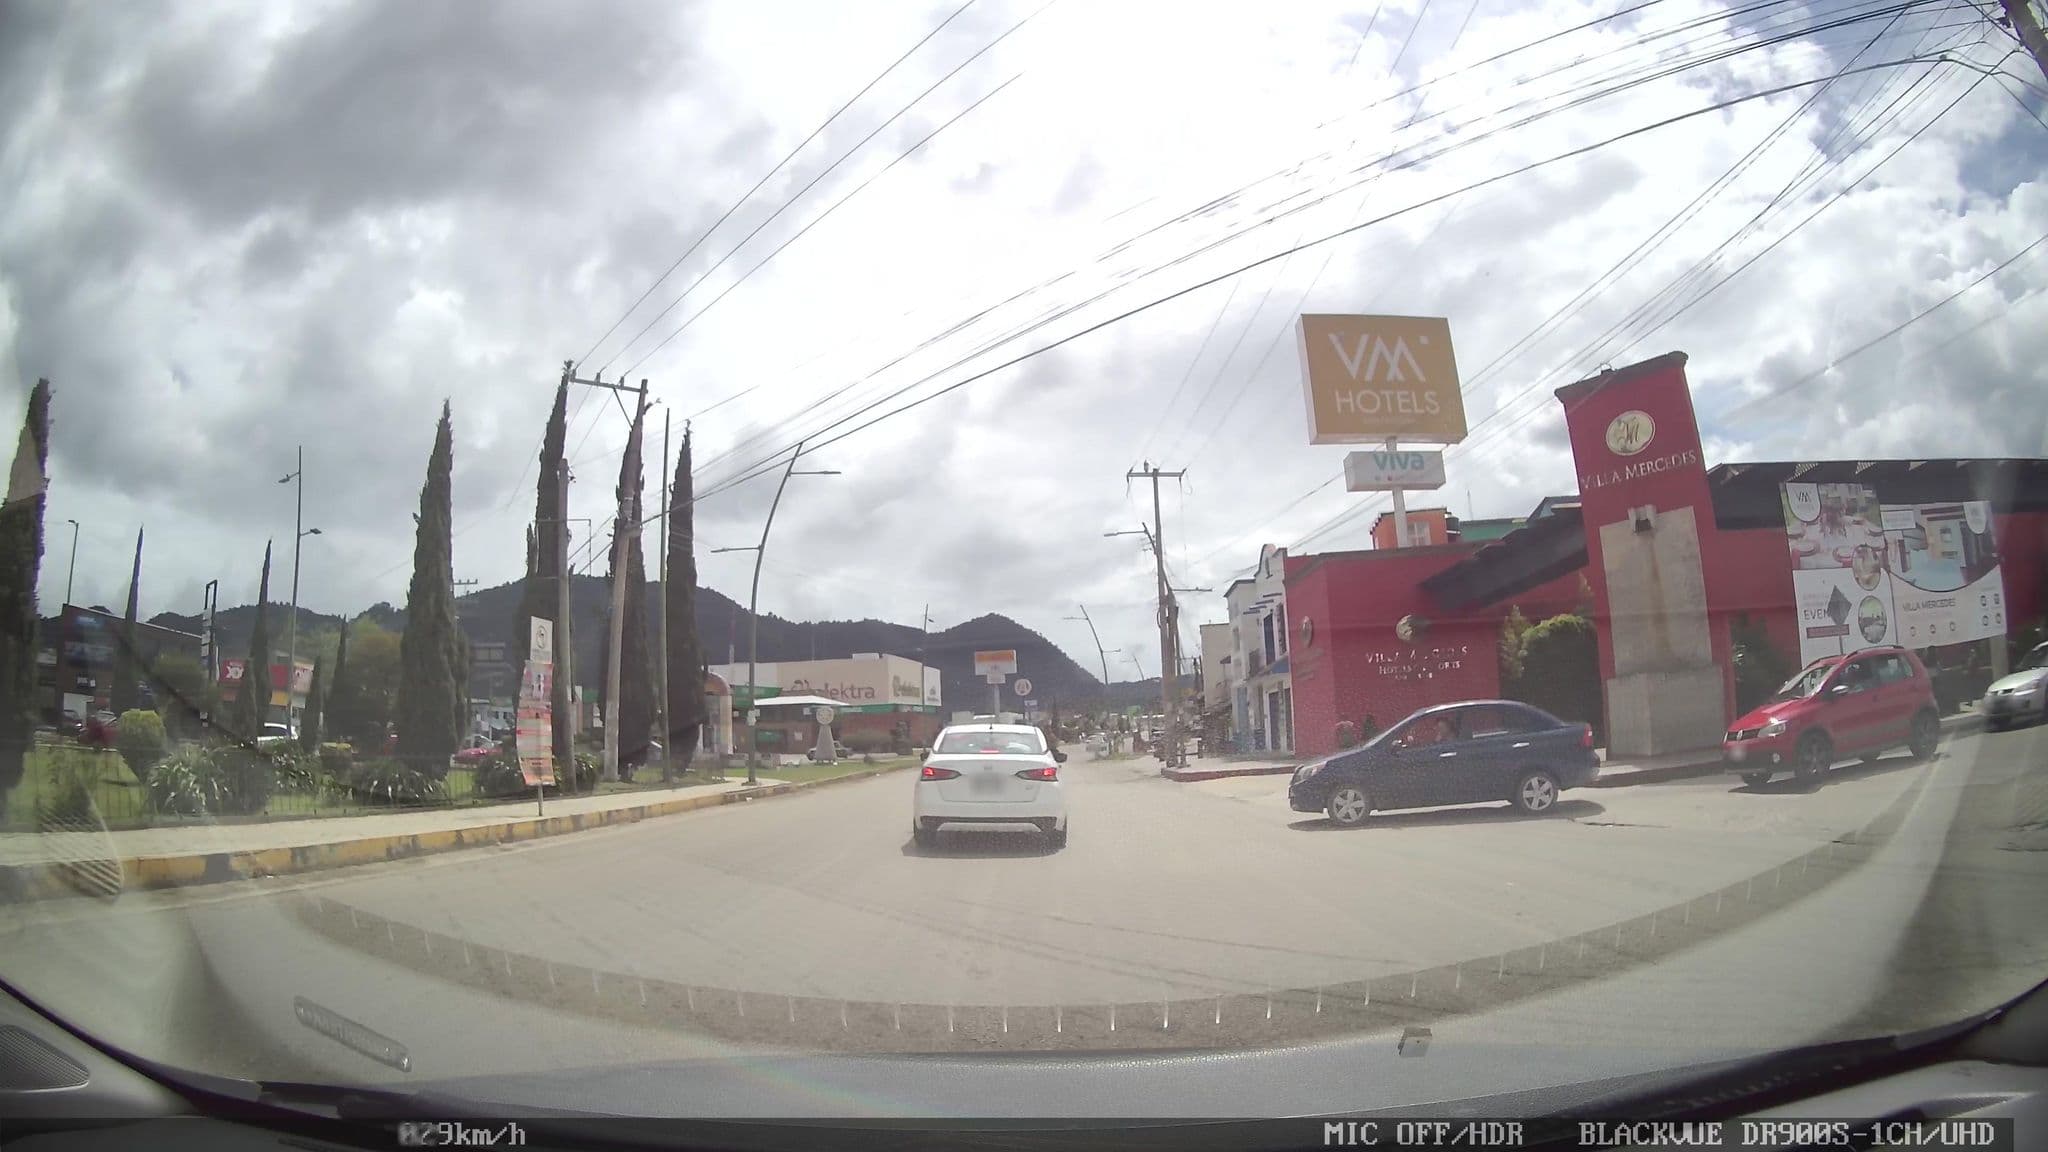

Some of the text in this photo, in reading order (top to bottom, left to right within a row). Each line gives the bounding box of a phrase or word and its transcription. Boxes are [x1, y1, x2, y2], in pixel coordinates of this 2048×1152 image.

[1336, 391, 1440, 415] HOTELS
[1373, 454, 1425, 470] viva
[1625, 449, 1697, 480] MERCEDES
